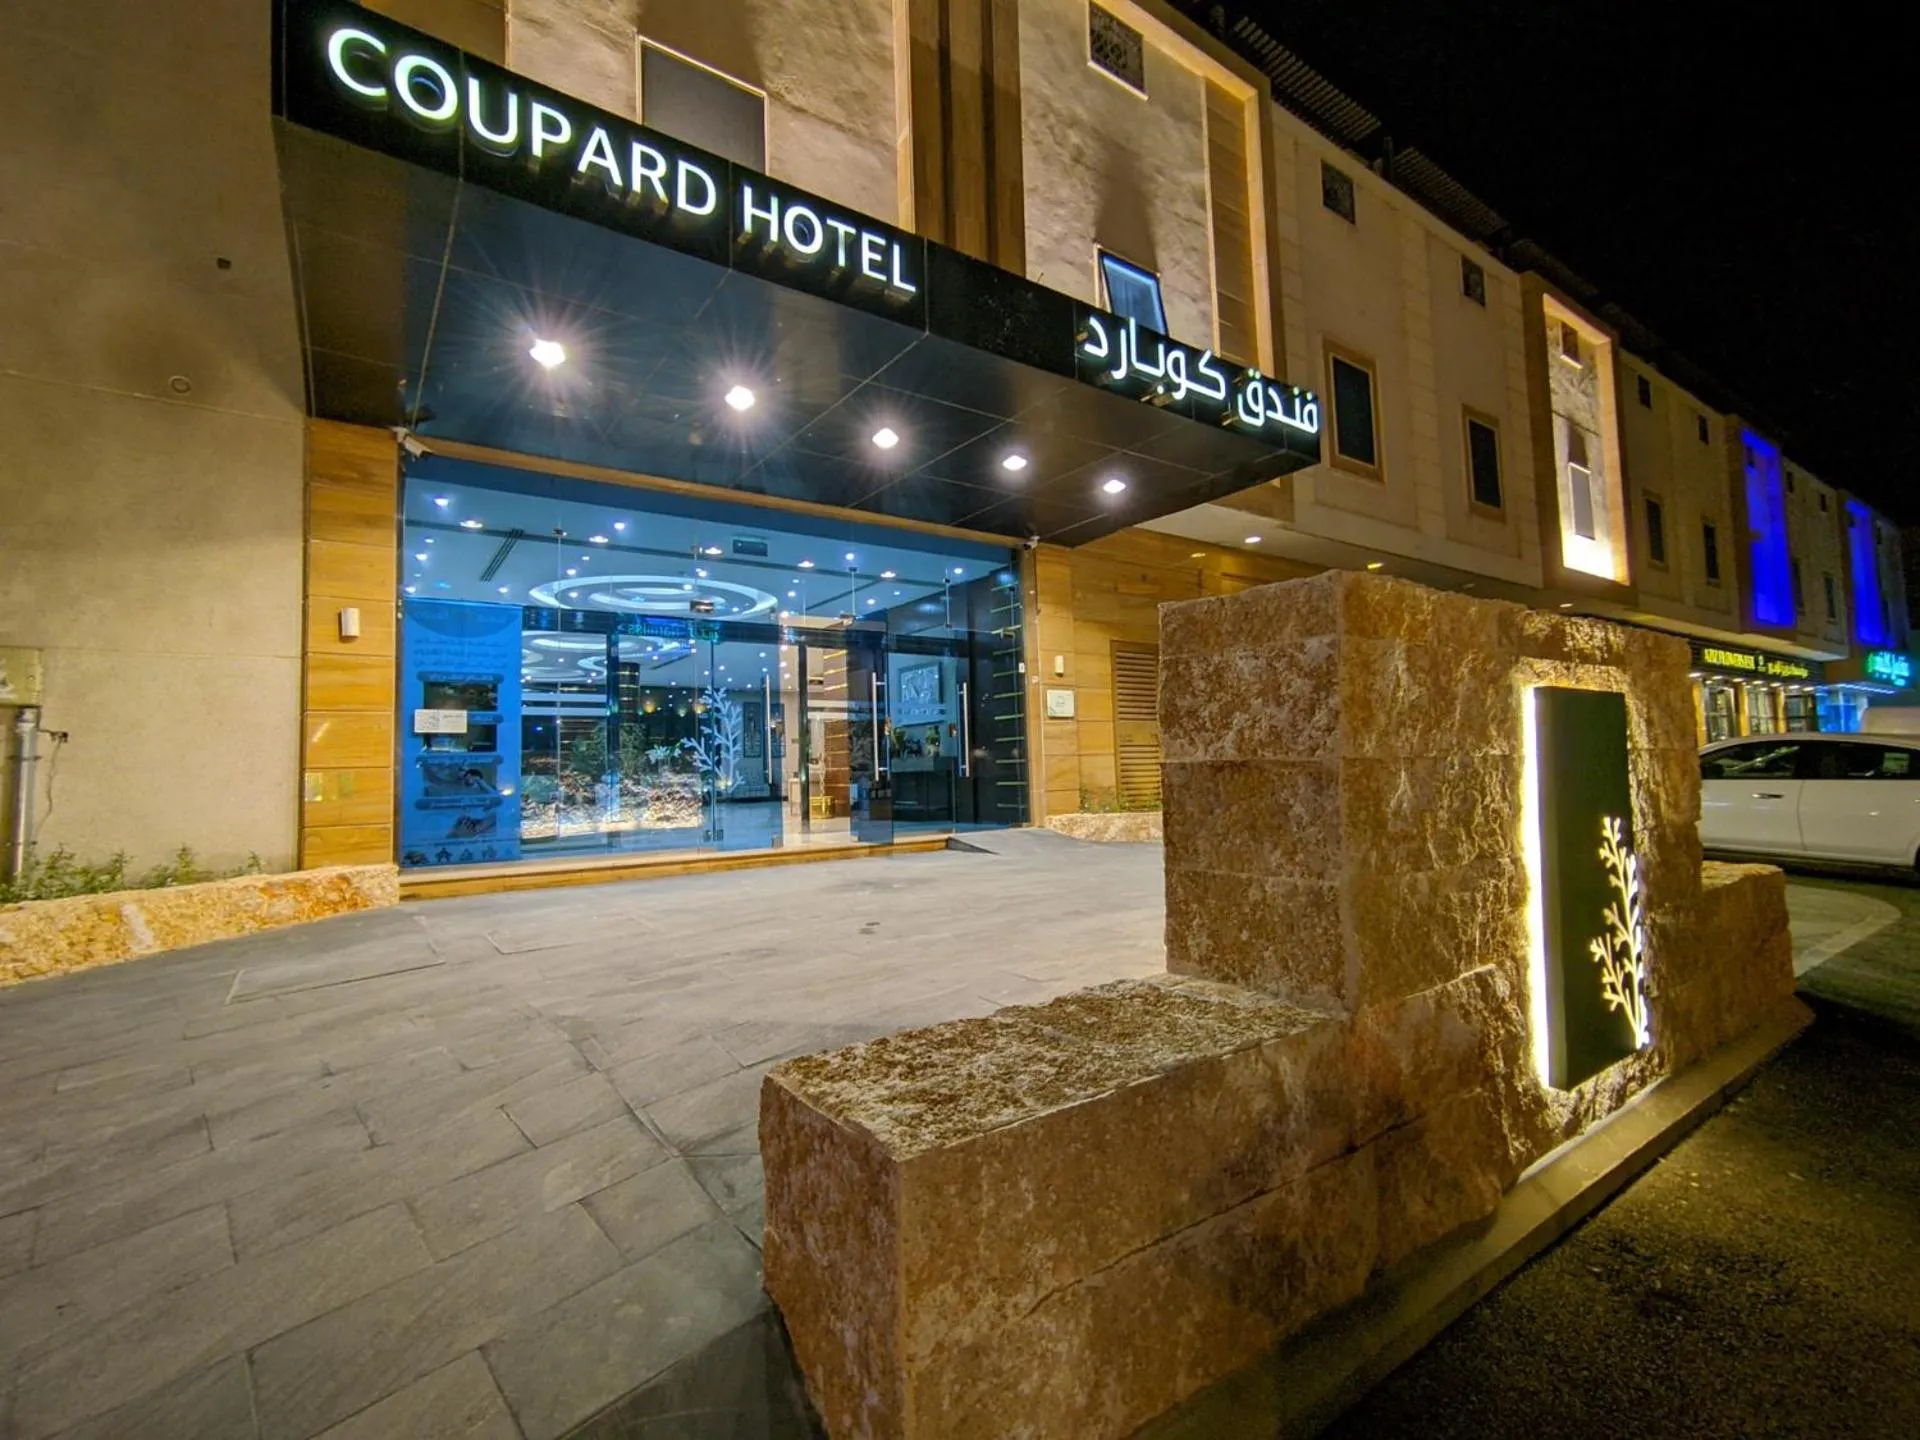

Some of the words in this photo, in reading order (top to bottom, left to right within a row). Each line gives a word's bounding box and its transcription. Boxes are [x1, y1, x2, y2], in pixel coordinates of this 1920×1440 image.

[327, 27, 718, 217] COUPARD
[742, 184, 917, 293] HOTEL
[1083, 316, 1227, 401] كوبارد
[1237, 367, 1319, 434] فندق
